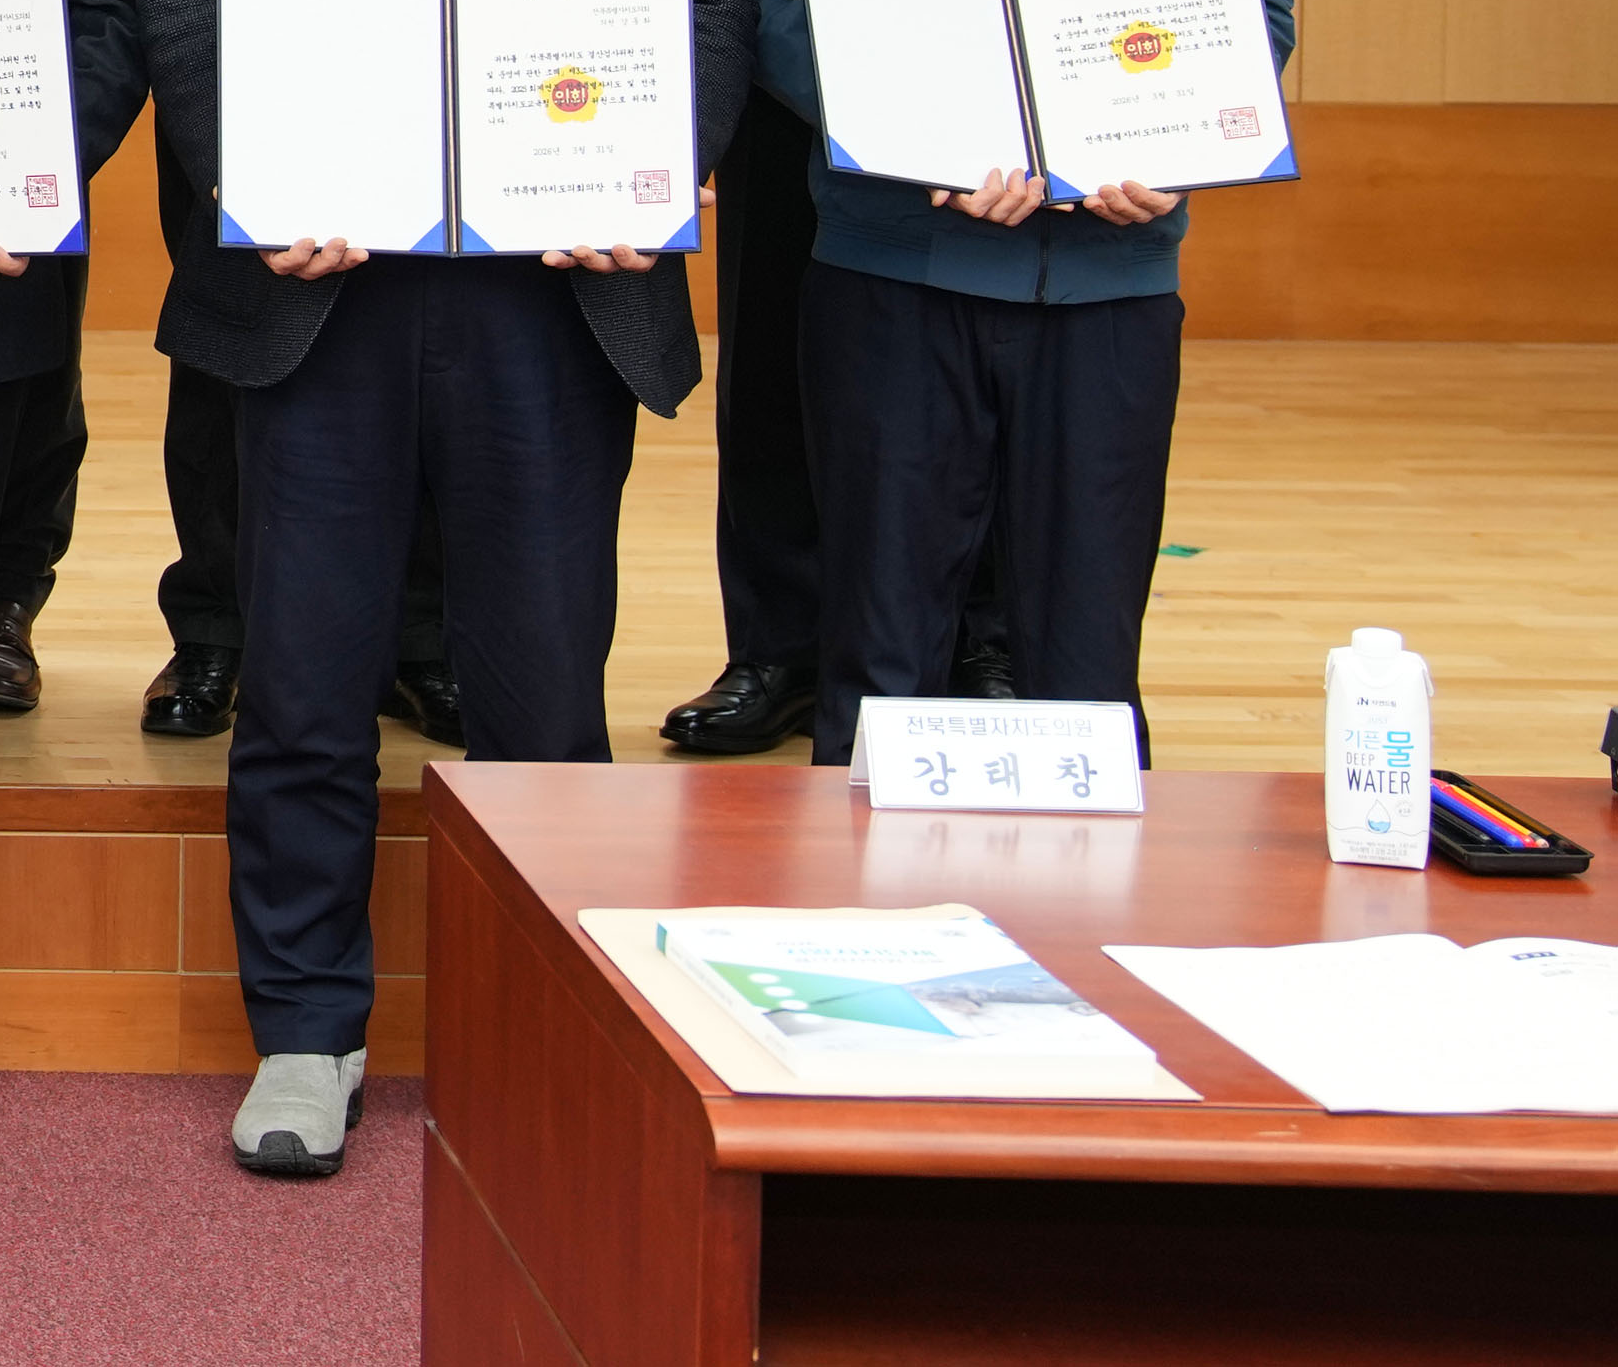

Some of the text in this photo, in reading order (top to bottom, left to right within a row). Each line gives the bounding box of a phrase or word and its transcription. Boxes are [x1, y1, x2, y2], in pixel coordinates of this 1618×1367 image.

[1124, 38, 1160, 57] 의회
[553, 86, 586, 104] 의회
[906, 716, 1093, 737] 전북특별자치도의원
[1346, 751, 1375, 767] DEEP
[1382, 731, 1414, 768] 물
[913, 751, 1098, 798] 강 태 창
[1346, 767, 1411, 795] WATER
